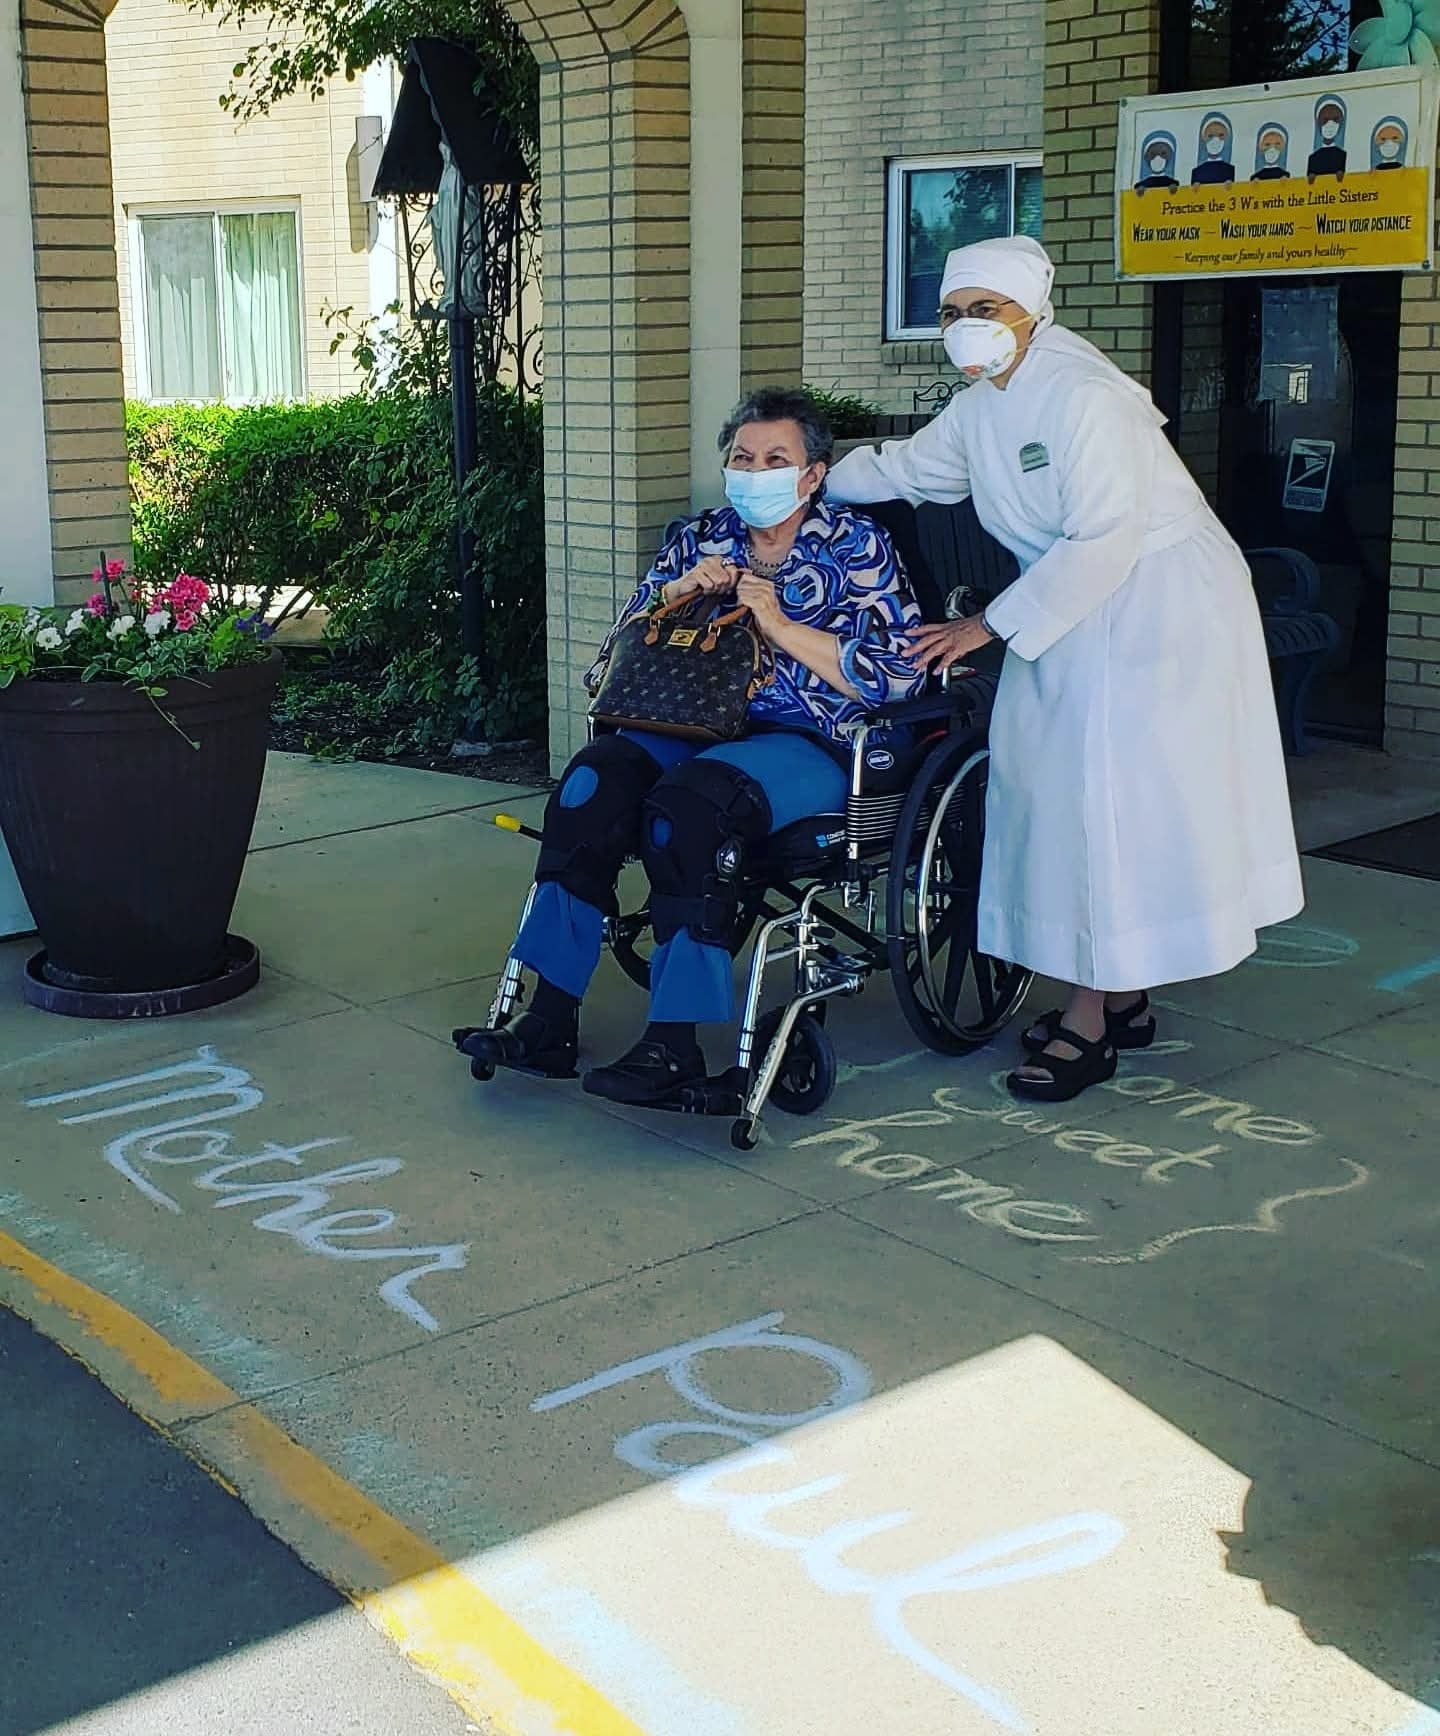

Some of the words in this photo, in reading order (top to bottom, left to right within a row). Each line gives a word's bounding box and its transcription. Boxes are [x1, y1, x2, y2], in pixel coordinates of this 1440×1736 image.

[1161, 201, 1205, 216] Practice
[1208, 199, 1225, 212] the
[1229, 198, 1237, 211] 3
[1262, 194, 1284, 209] with
[1288, 193, 1305, 207] the
[1307, 190, 1337, 205] Little
[1339, 187, 1379, 203] Sisters
[1132, 222, 1154, 243] WEAR
[1156, 227, 1177, 242] YOUR
[1179, 225, 1201, 241] MASK
[1221, 218, 1245, 240] WASH
[1247, 223, 1269, 238] YOUR
[1269, 221, 1295, 237] HANDS
[1316, 213, 1346, 235] WATCH
[1349, 217, 1371, 233] YOUR
[1370, 214, 1412, 231] DISTANCE
[1221, 253, 1237, 262] our
[1235, 247, 1265, 264] family
[1267, 245, 1285, 259] and
[1286, 249, 1313, 262] yours
